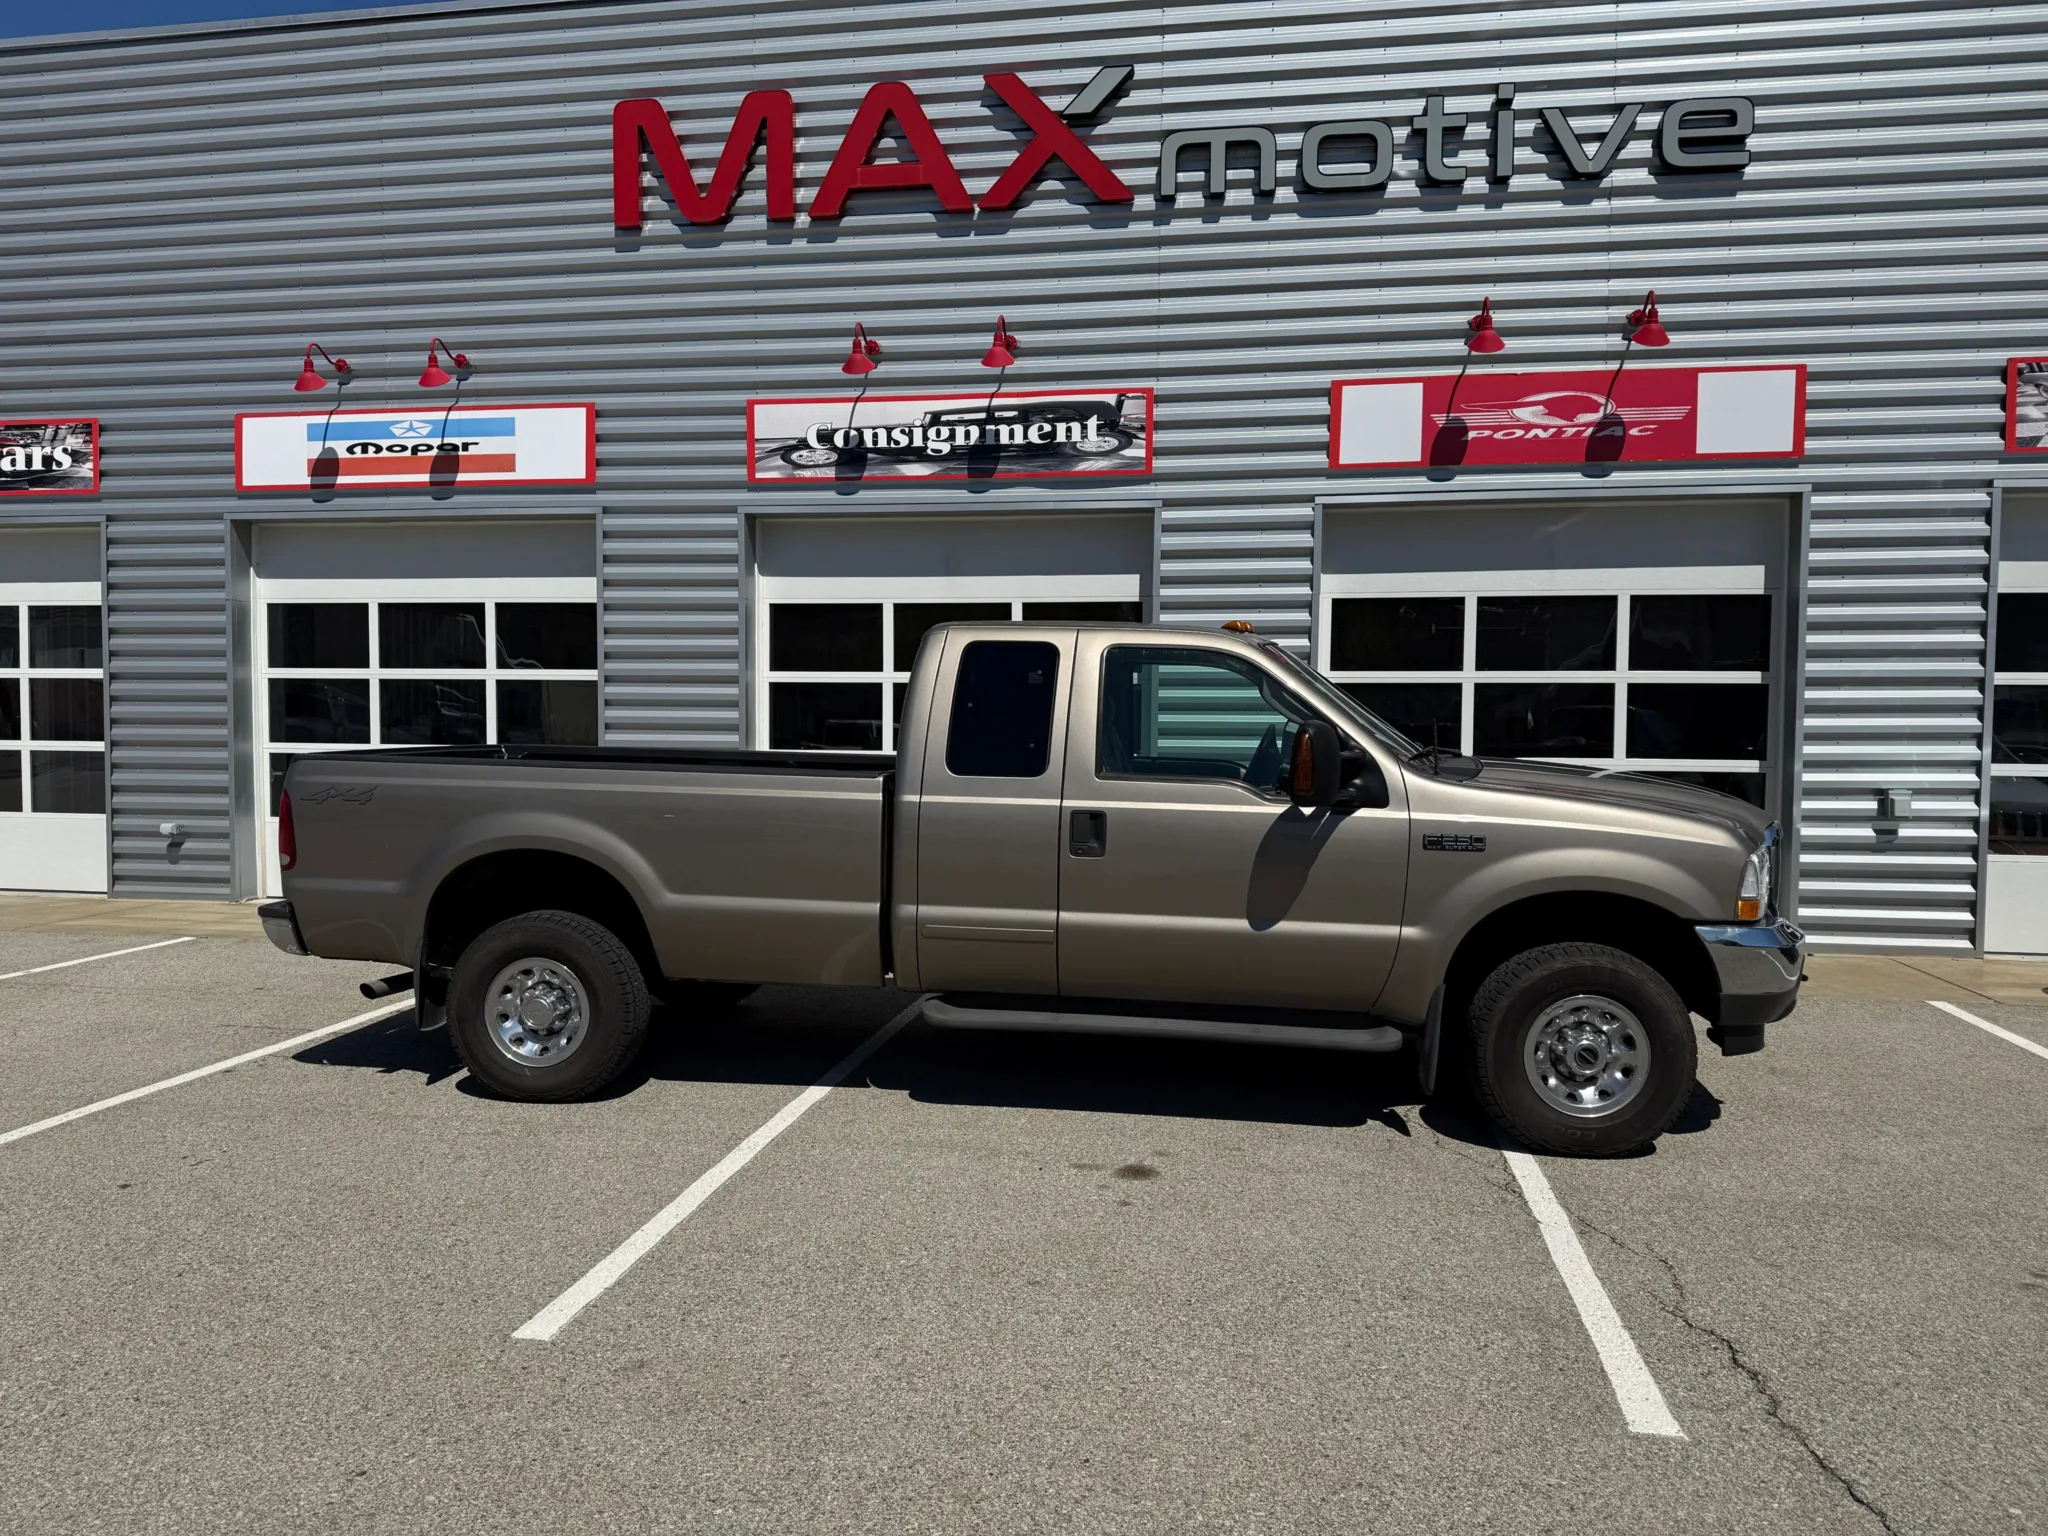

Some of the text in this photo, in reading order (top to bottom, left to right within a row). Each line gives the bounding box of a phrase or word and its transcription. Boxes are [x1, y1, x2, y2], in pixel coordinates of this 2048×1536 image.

[612, 64, 1756, 229] MAX motive
[806, 414, 1105, 456] Consignment
[1461, 424, 1658, 441] PONTIAC
